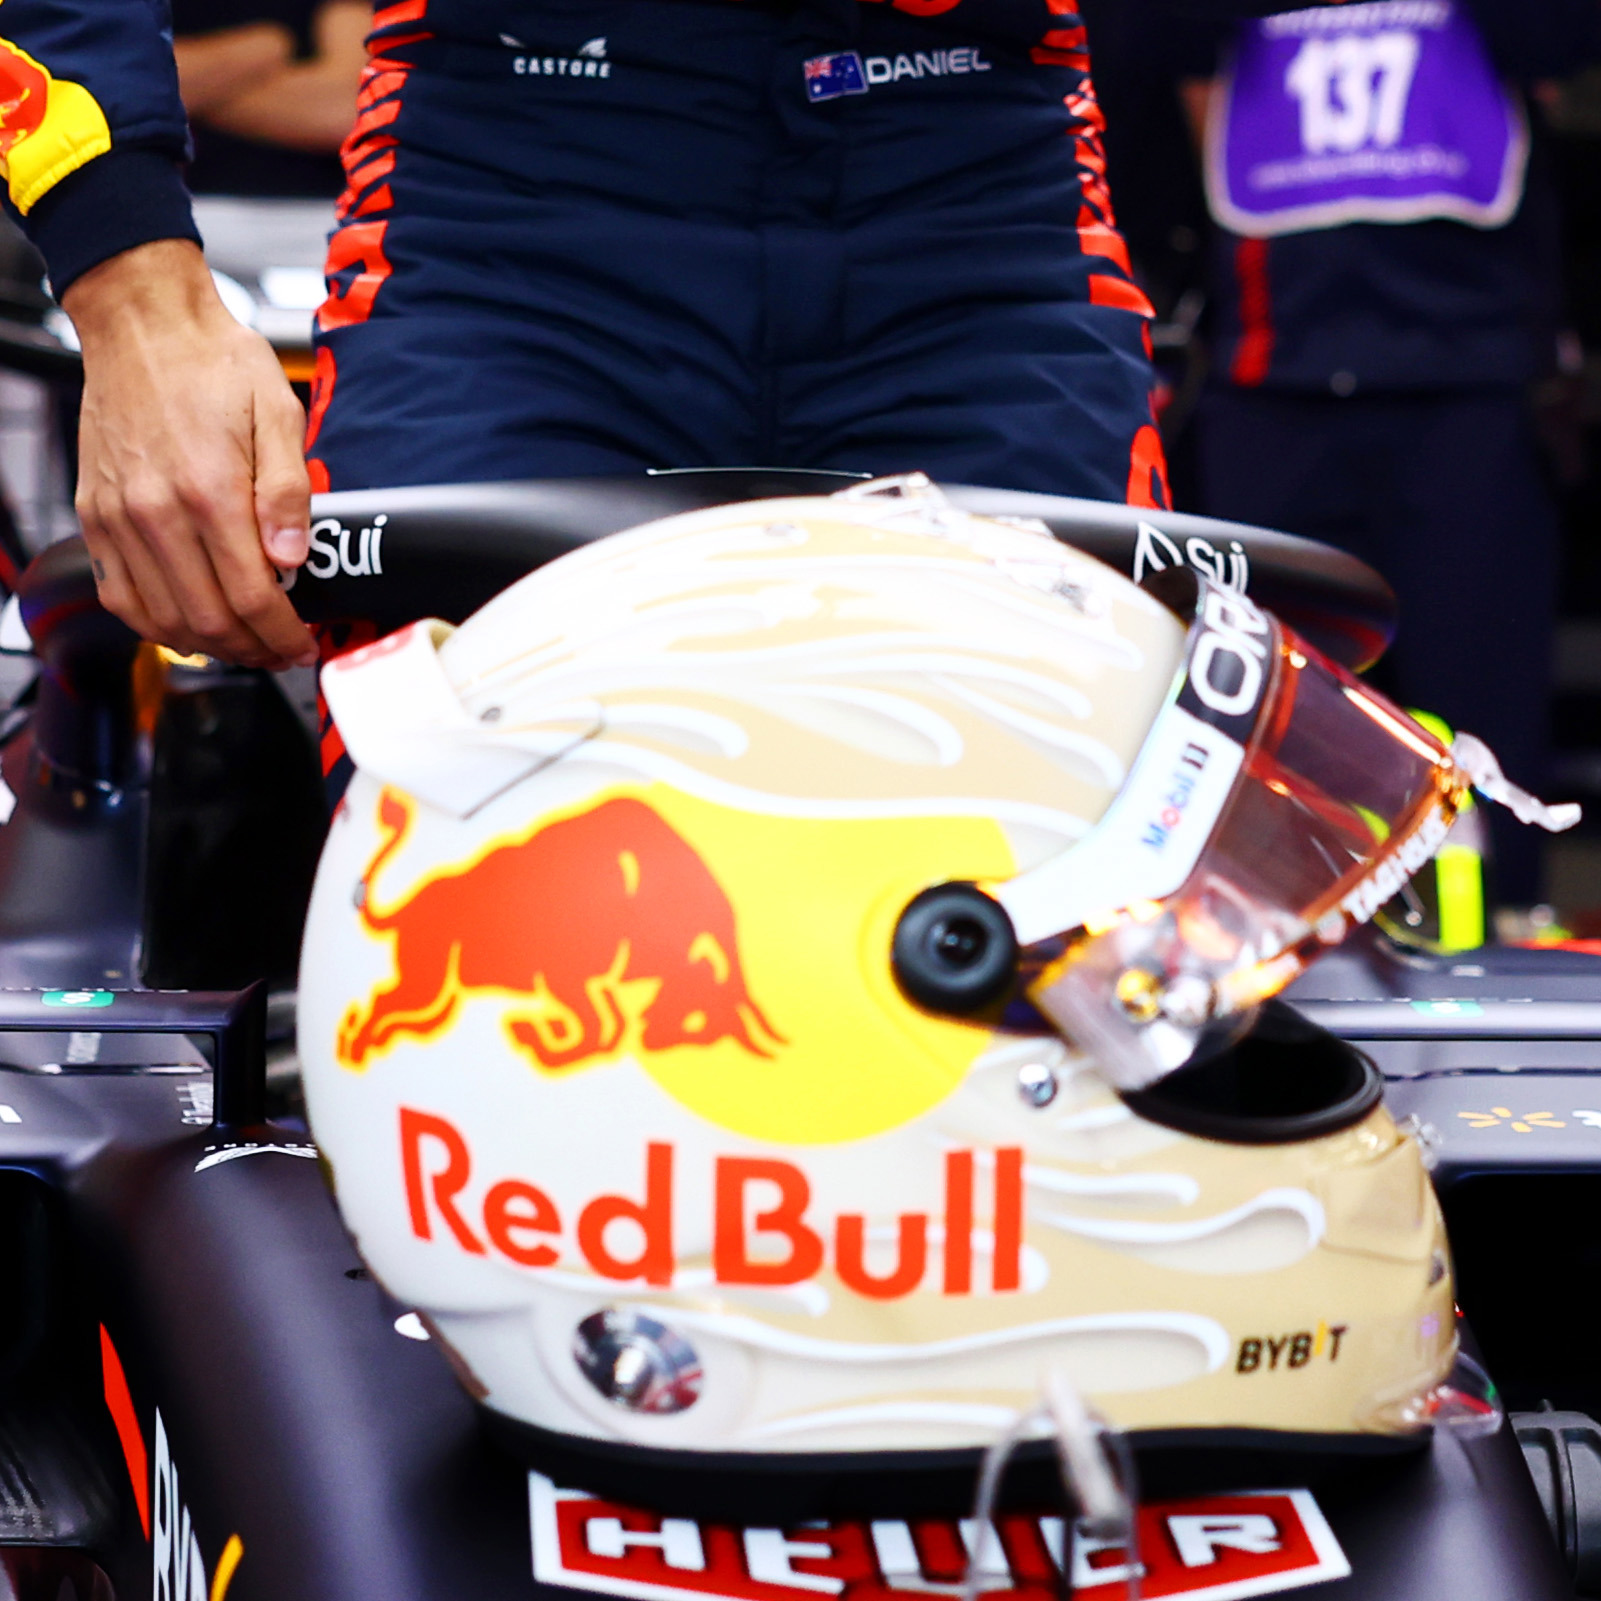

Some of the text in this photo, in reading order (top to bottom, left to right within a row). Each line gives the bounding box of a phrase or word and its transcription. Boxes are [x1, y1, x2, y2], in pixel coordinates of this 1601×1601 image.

[514, 57, 612, 80] CASTORE
[866, 47, 992, 85] DANIEL
[306, 514, 388, 580] Sui
[399, 1107, 1024, 1300] Red Bull
[1235, 1317, 1349, 1374] BYBIT
